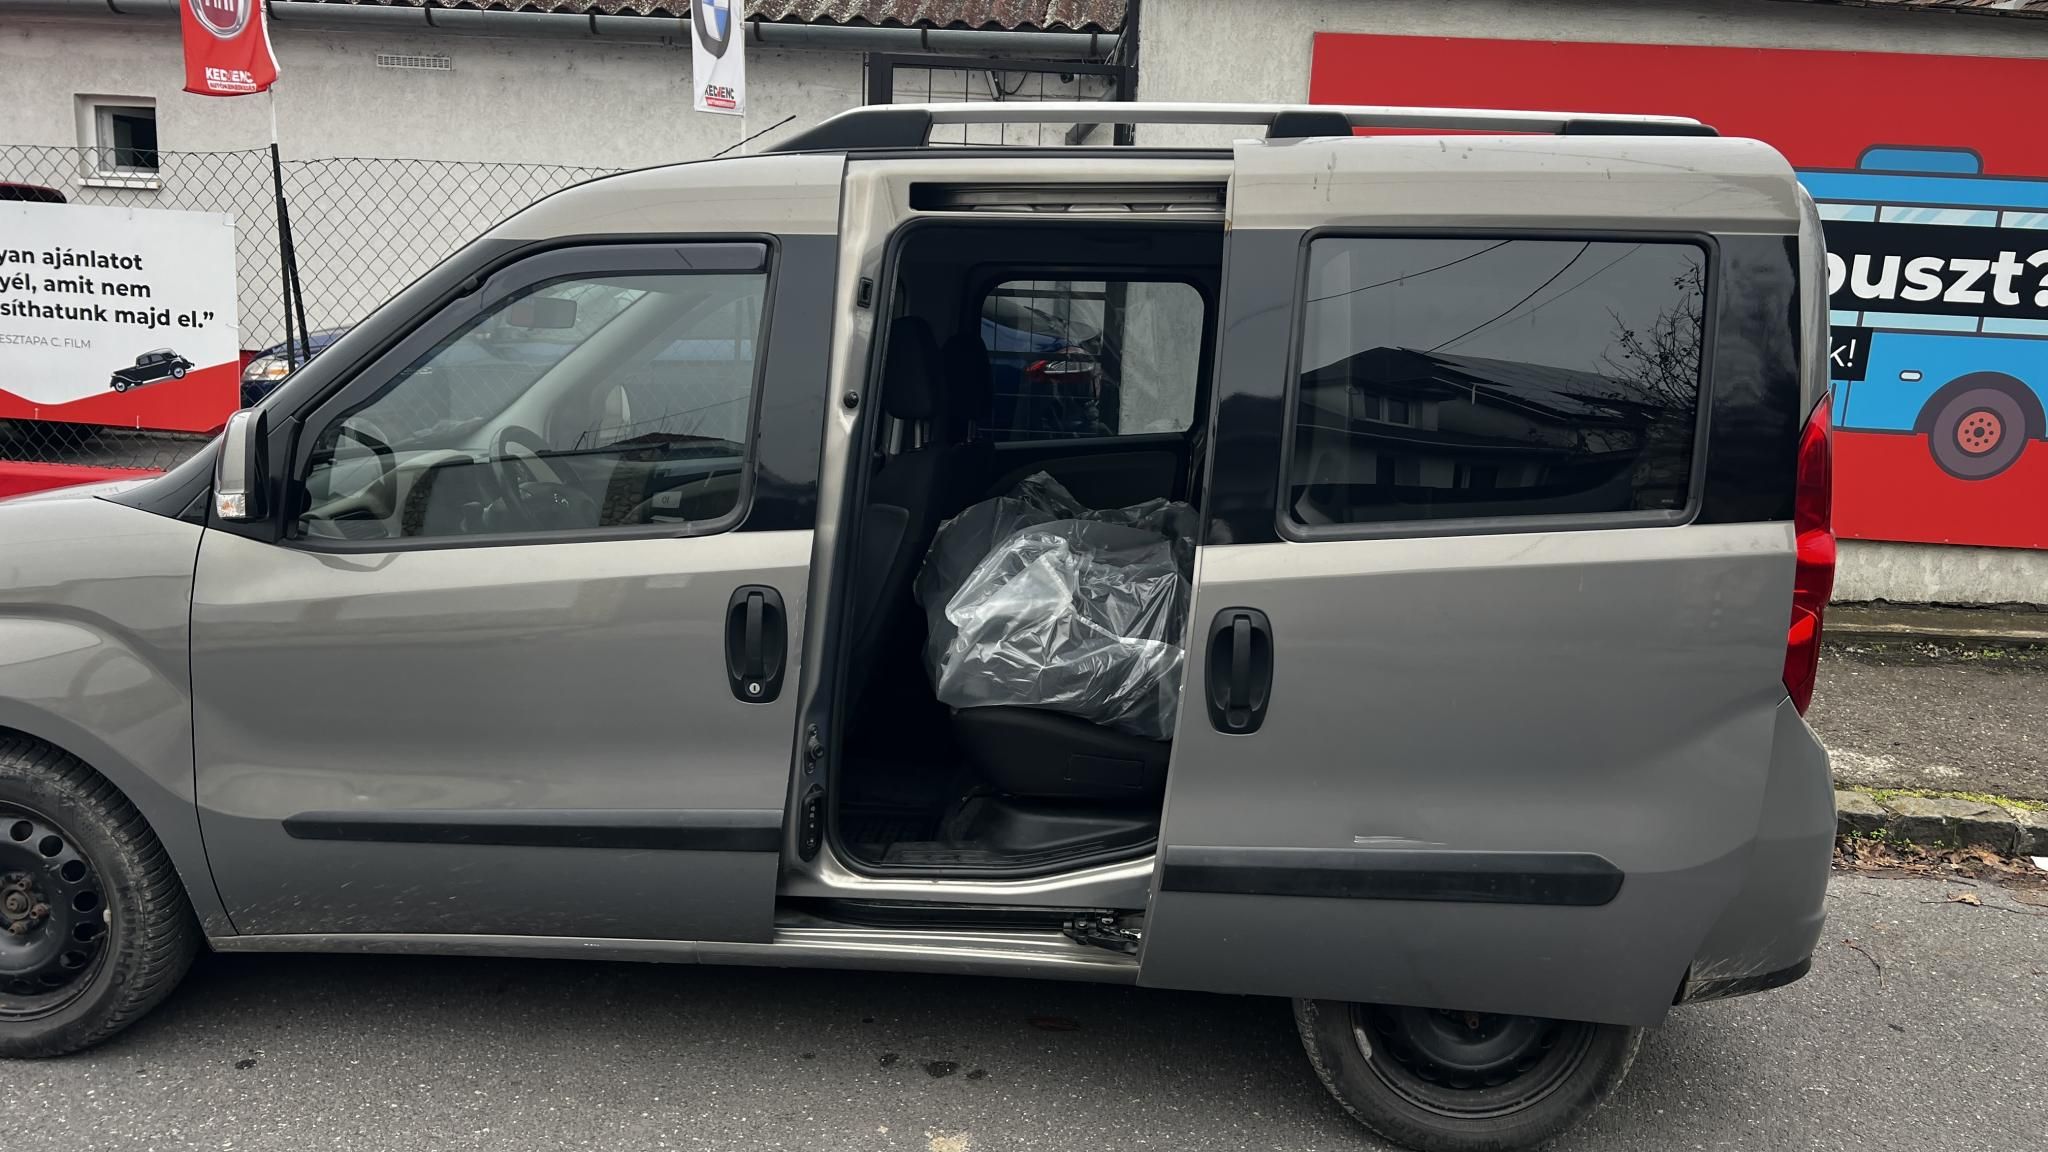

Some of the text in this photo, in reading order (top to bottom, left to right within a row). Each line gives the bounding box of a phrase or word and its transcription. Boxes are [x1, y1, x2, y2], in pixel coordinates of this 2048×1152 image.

[42, 247, 143, 270] ajánlatot
[0, 272, 151, 298] yél, amit nem
[1, 299, 108, 322] síthatunk
[115, 306, 170, 329] majd
[64, 338, 91, 349] FILM
